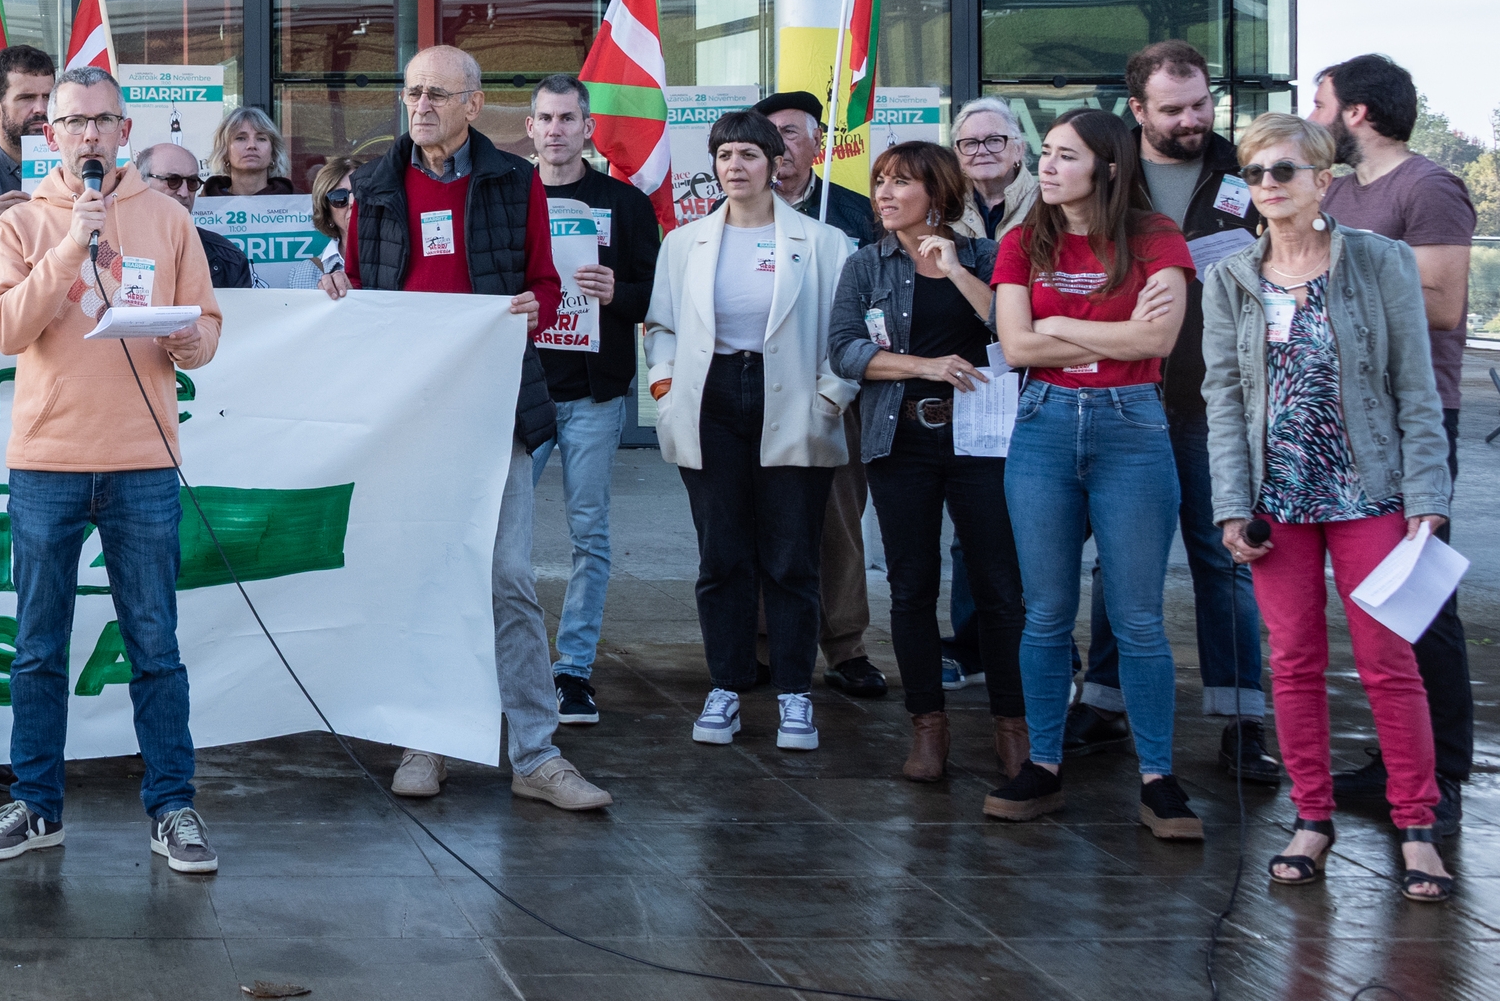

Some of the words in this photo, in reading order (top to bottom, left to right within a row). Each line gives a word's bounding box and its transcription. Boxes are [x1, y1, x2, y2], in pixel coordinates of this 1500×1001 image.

[160, 73, 171, 81] 28
[129, 87, 207, 101] BIARRITZ
[695, 94, 707, 102] 28
[876, 95, 887, 103] 28
[673, 171, 691, 181] ace
[549, 207, 583, 215] ovembre
[194, 213, 223, 225] roak
[225, 210, 247, 225] 28
[533, 332, 590, 346] RRESIA
